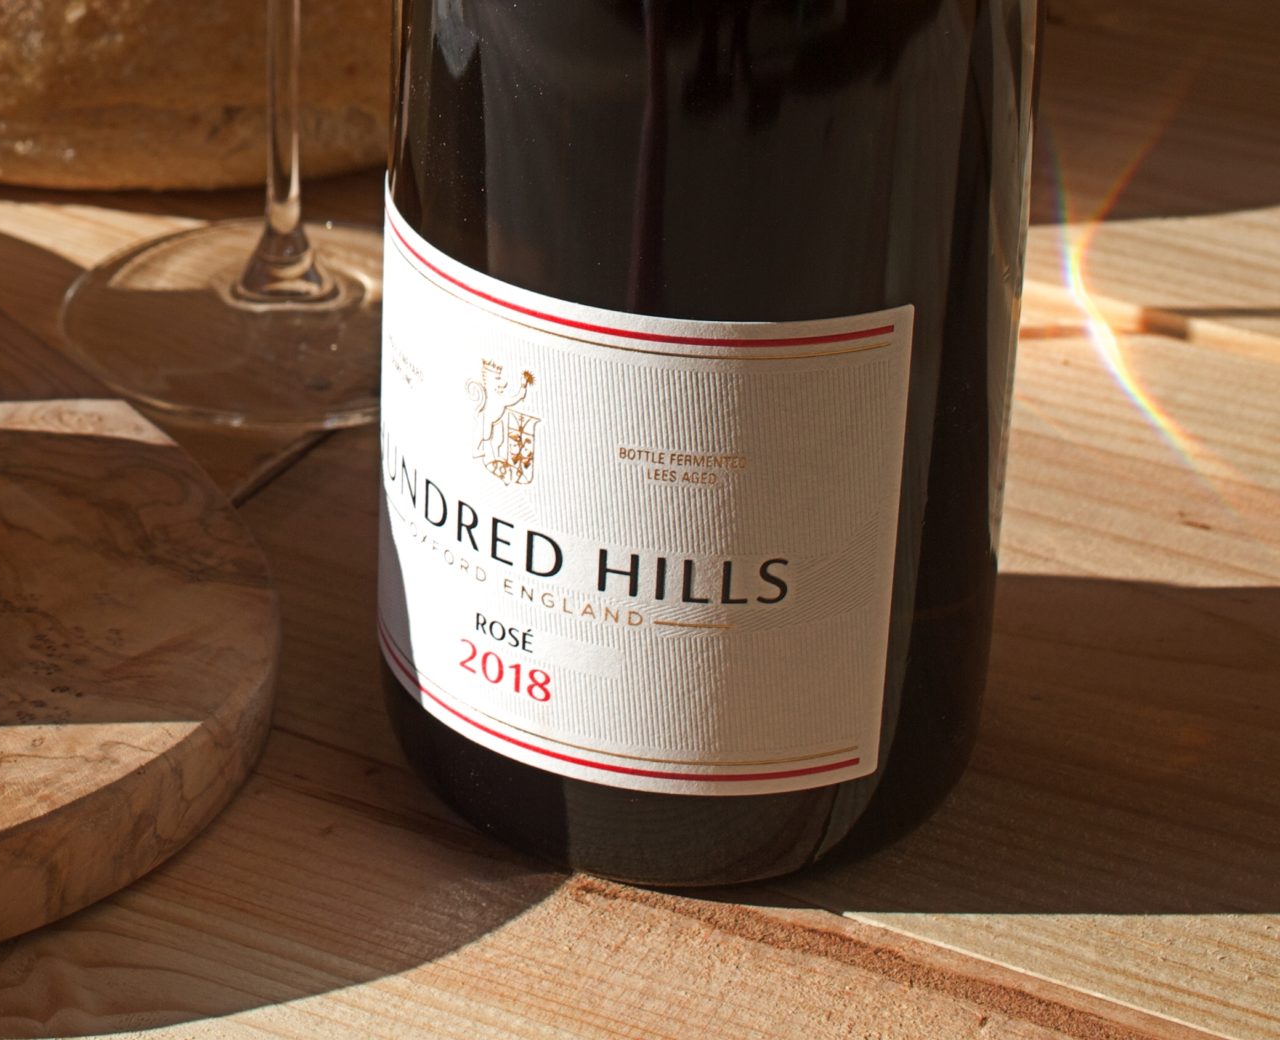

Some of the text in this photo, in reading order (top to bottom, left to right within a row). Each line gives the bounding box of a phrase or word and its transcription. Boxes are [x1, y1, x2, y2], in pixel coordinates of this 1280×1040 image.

[619, 447, 748, 469] BOTTLE FERMENTED
[647, 469, 717, 485] LEES AGED
[598, 548, 789, 605] HILLS
[503, 578, 644, 627] ENGLAND
[476, 612, 534, 654] ROSÉ
[458, 638, 552, 703] 2018
